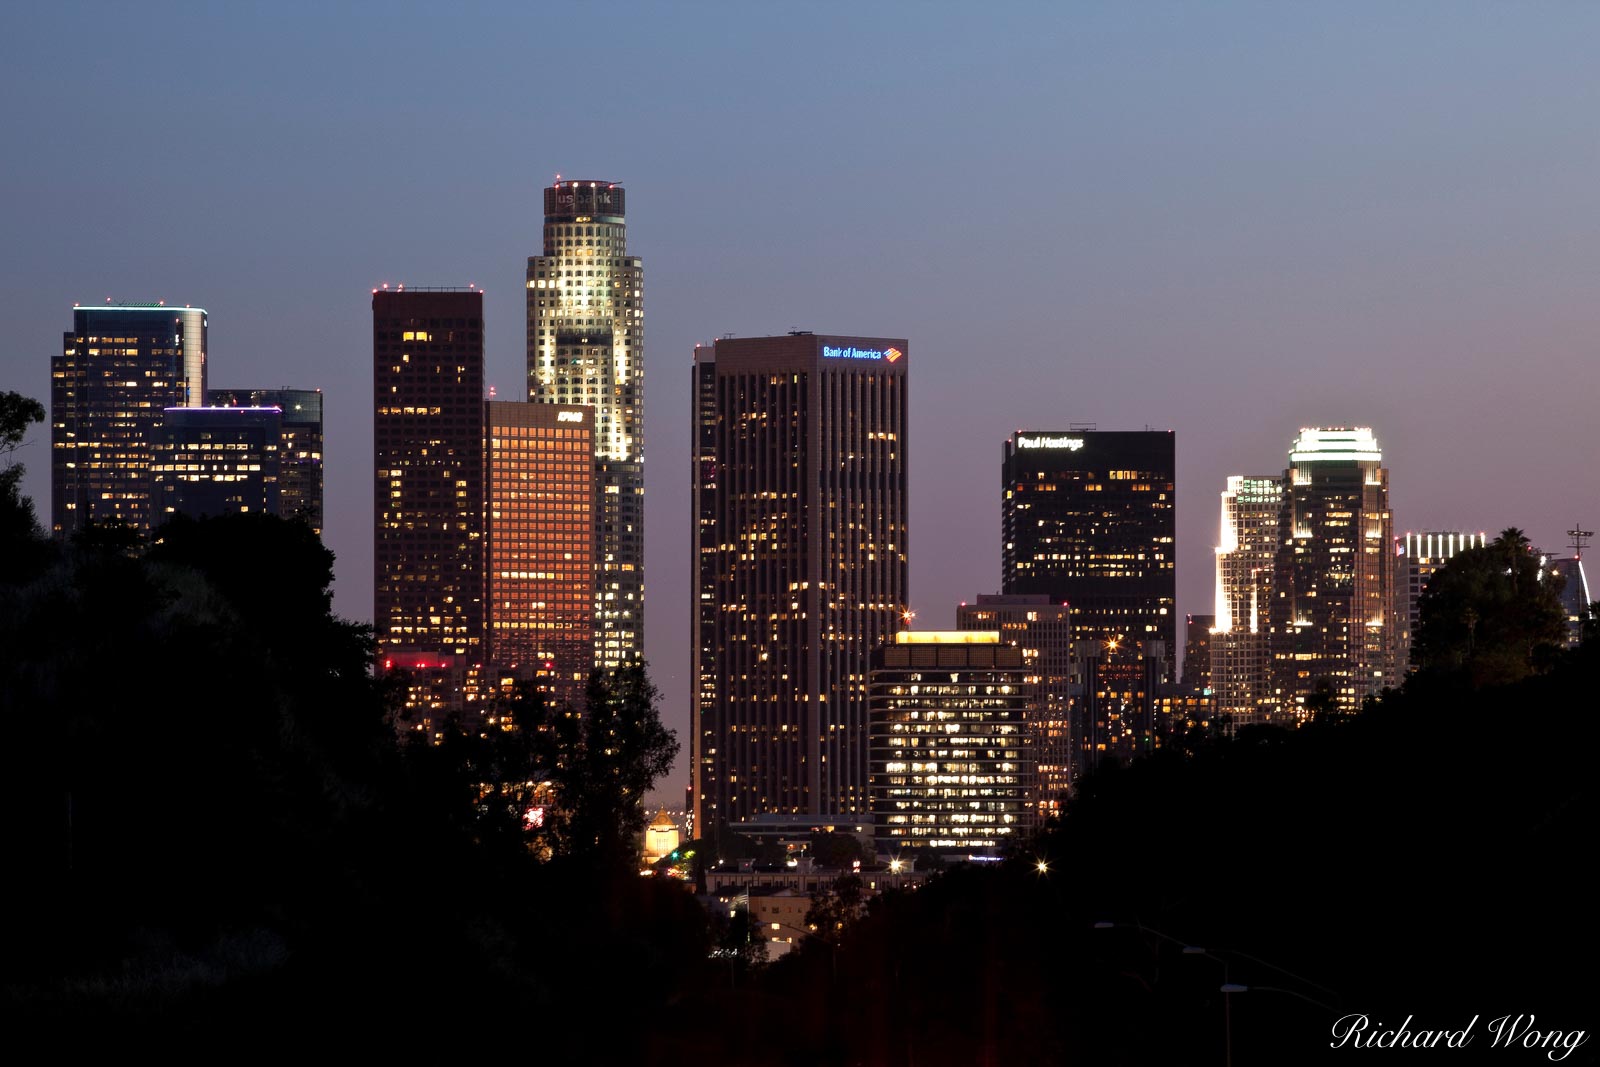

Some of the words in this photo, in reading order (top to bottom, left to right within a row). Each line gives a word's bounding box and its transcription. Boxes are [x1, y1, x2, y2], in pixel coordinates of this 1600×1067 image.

[823, 346, 842, 357] Bank
[842, 347, 851, 358] of
[851, 347, 882, 359] America
[1018, 436, 1040, 448] Paul
[1040, 436, 1084, 452] Hastings
